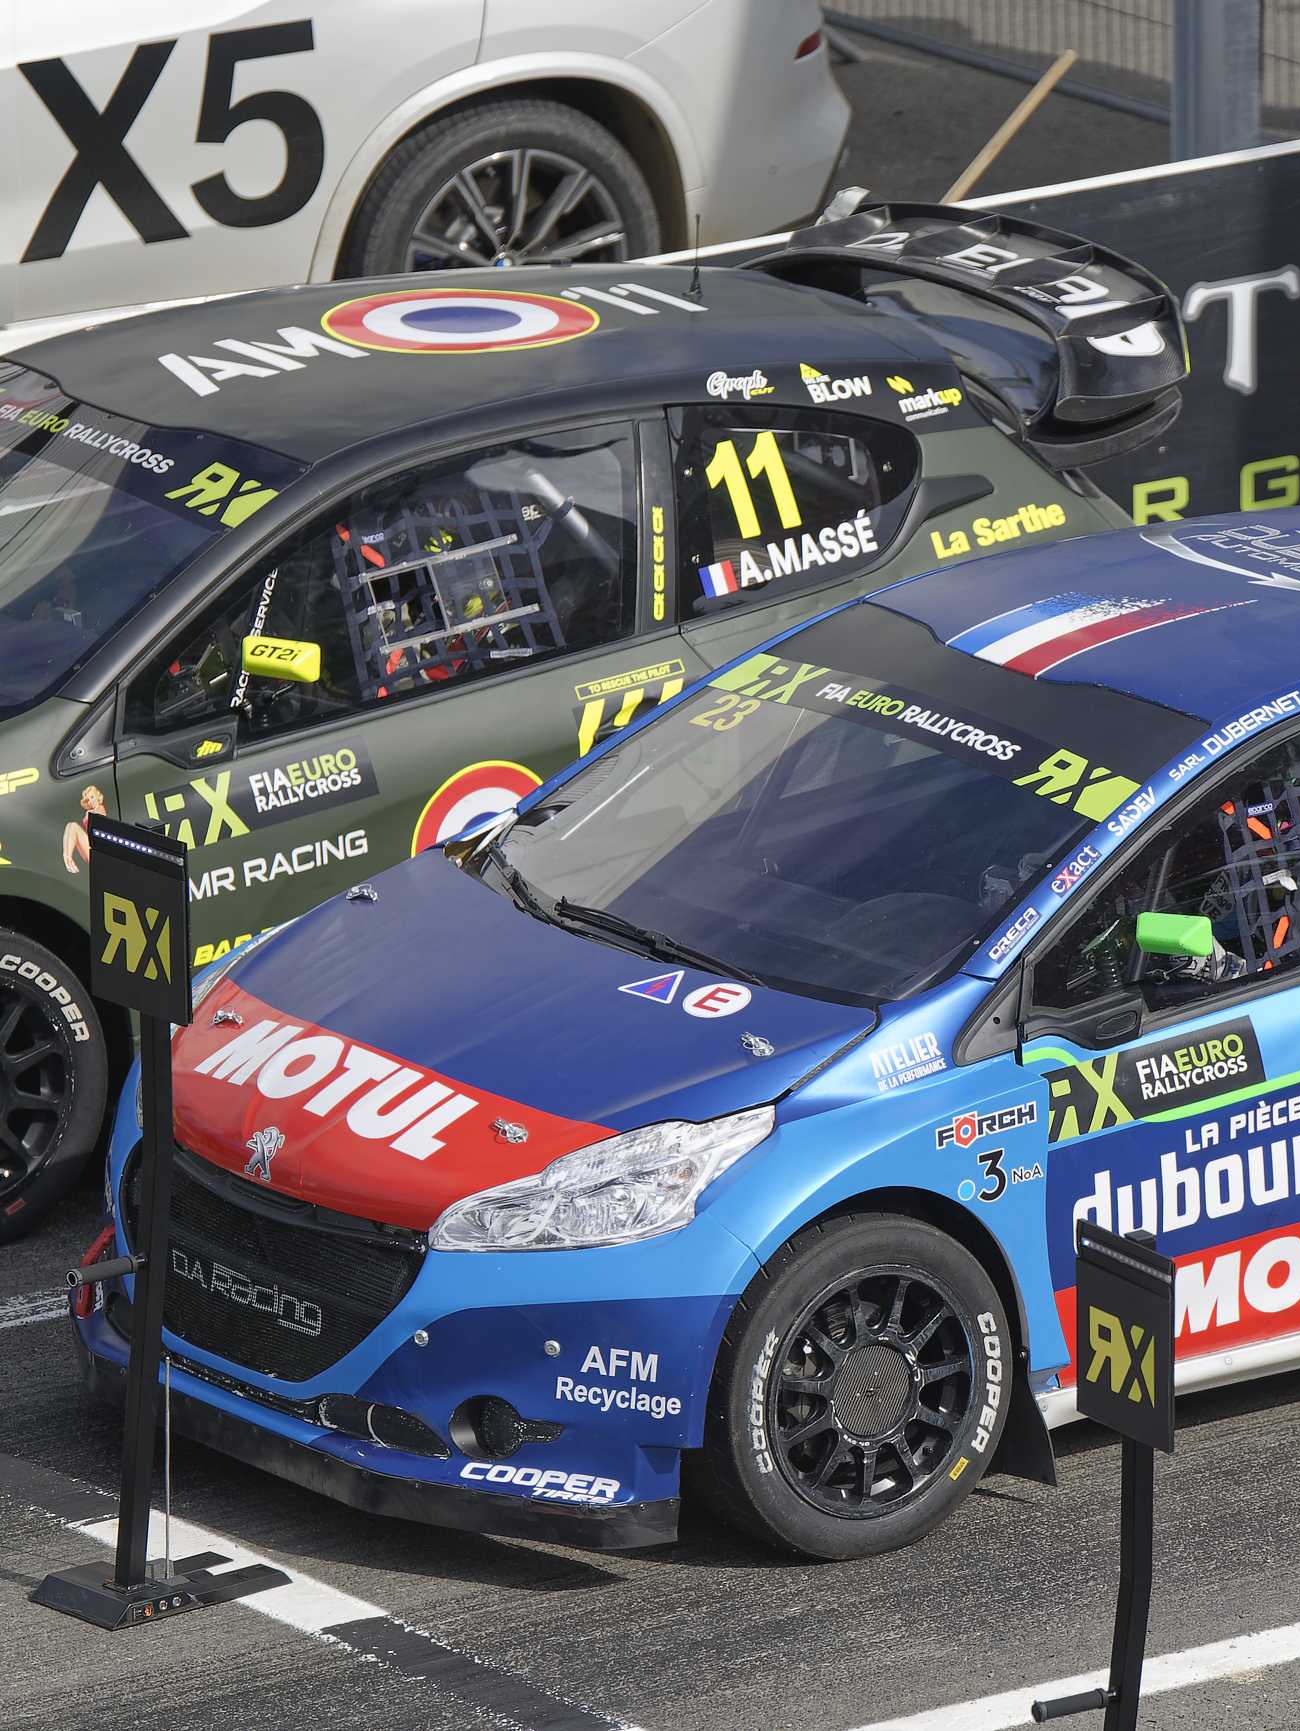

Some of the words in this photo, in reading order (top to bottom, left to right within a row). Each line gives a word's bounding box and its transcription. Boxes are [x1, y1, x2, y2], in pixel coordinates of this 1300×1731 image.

[16, 18, 325, 264] X5
[806, 376, 872, 404] BLOW
[898, 388, 962, 414] markup
[17, 410, 70, 433] EURO
[63, 423, 175, 474] RALLYCROSS
[705, 430, 802, 539] 11
[930, 525, 973, 560] La
[972, 501, 1067, 546] Sarthe
[250, 644, 302, 661] GT2i
[688, 694, 761, 732] 23
[815, 682, 851, 702] FIA
[846, 690, 905, 716] EURO
[897, 704, 1021, 761] RALLYCROSS
[255, 768, 362, 813] RALLYCROSS
[1168, 753, 1206, 783] SARL
[242, 829, 369, 887] RACING
[0, 954, 90, 1041] COOPER
[692, 987, 742, 1013] E
[870, 1032, 942, 1078] ATELIER
[1141, 1054, 1248, 1100] RALLYCROSS
[194, 1019, 480, 1161] MOTUL
[1185, 1121, 1220, 1154] LA
[977, 1148, 1008, 1203] 3
[172, 1248, 207, 1288] DA
[580, 1345, 659, 1382] AFM
[970, 1311, 1003, 1457] COOPER
[556, 1376, 682, 1419] Recyclage
[460, 1462, 621, 1499] COOPER
